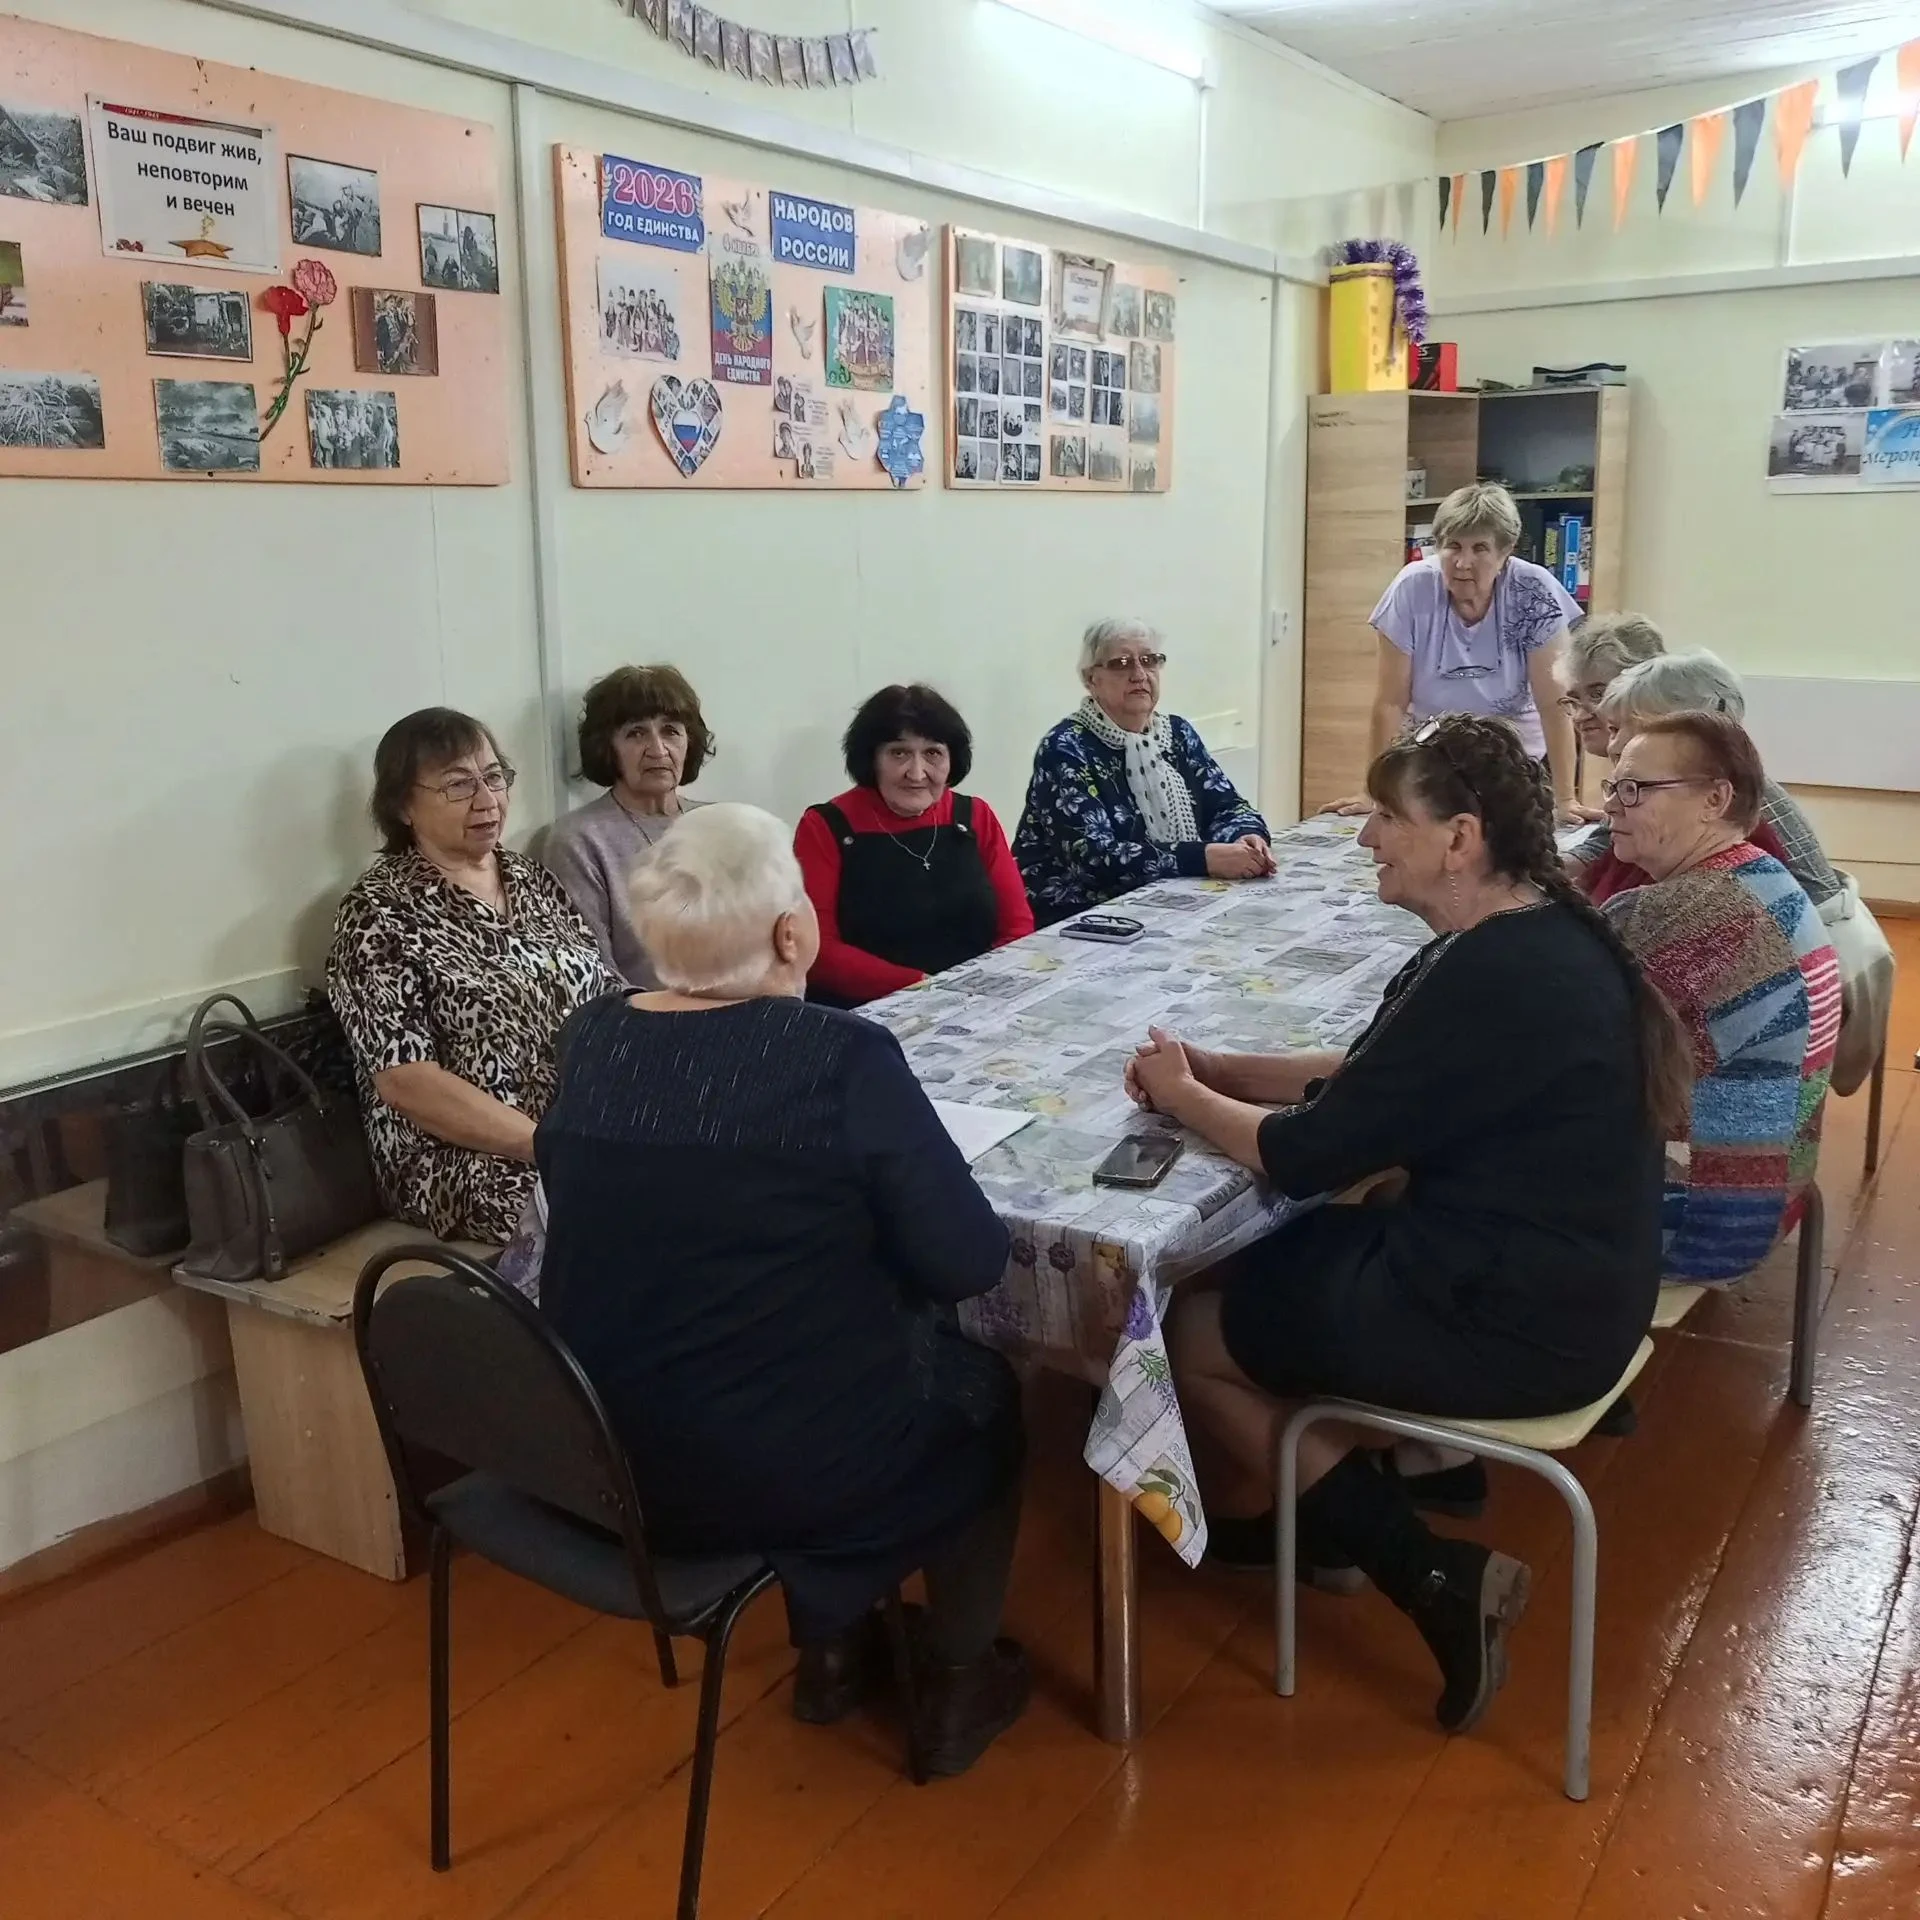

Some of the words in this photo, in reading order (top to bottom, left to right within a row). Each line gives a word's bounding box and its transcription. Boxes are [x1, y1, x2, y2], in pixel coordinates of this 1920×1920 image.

[107, 121, 147, 144] Ваш
[153, 132, 216, 155] подвиг
[221, 143, 262, 165] жив,
[138, 162, 248, 190] неповторим
[614, 164, 695, 217] 2026
[166, 195, 177, 209] и
[183, 197, 235, 216] вечен
[775, 198, 854, 233] НАРОДОВ
[607, 211, 634, 232] ГОД
[637, 219, 700, 242] ЕДИНСТВА
[781, 236, 849, 268] РОССИИ
